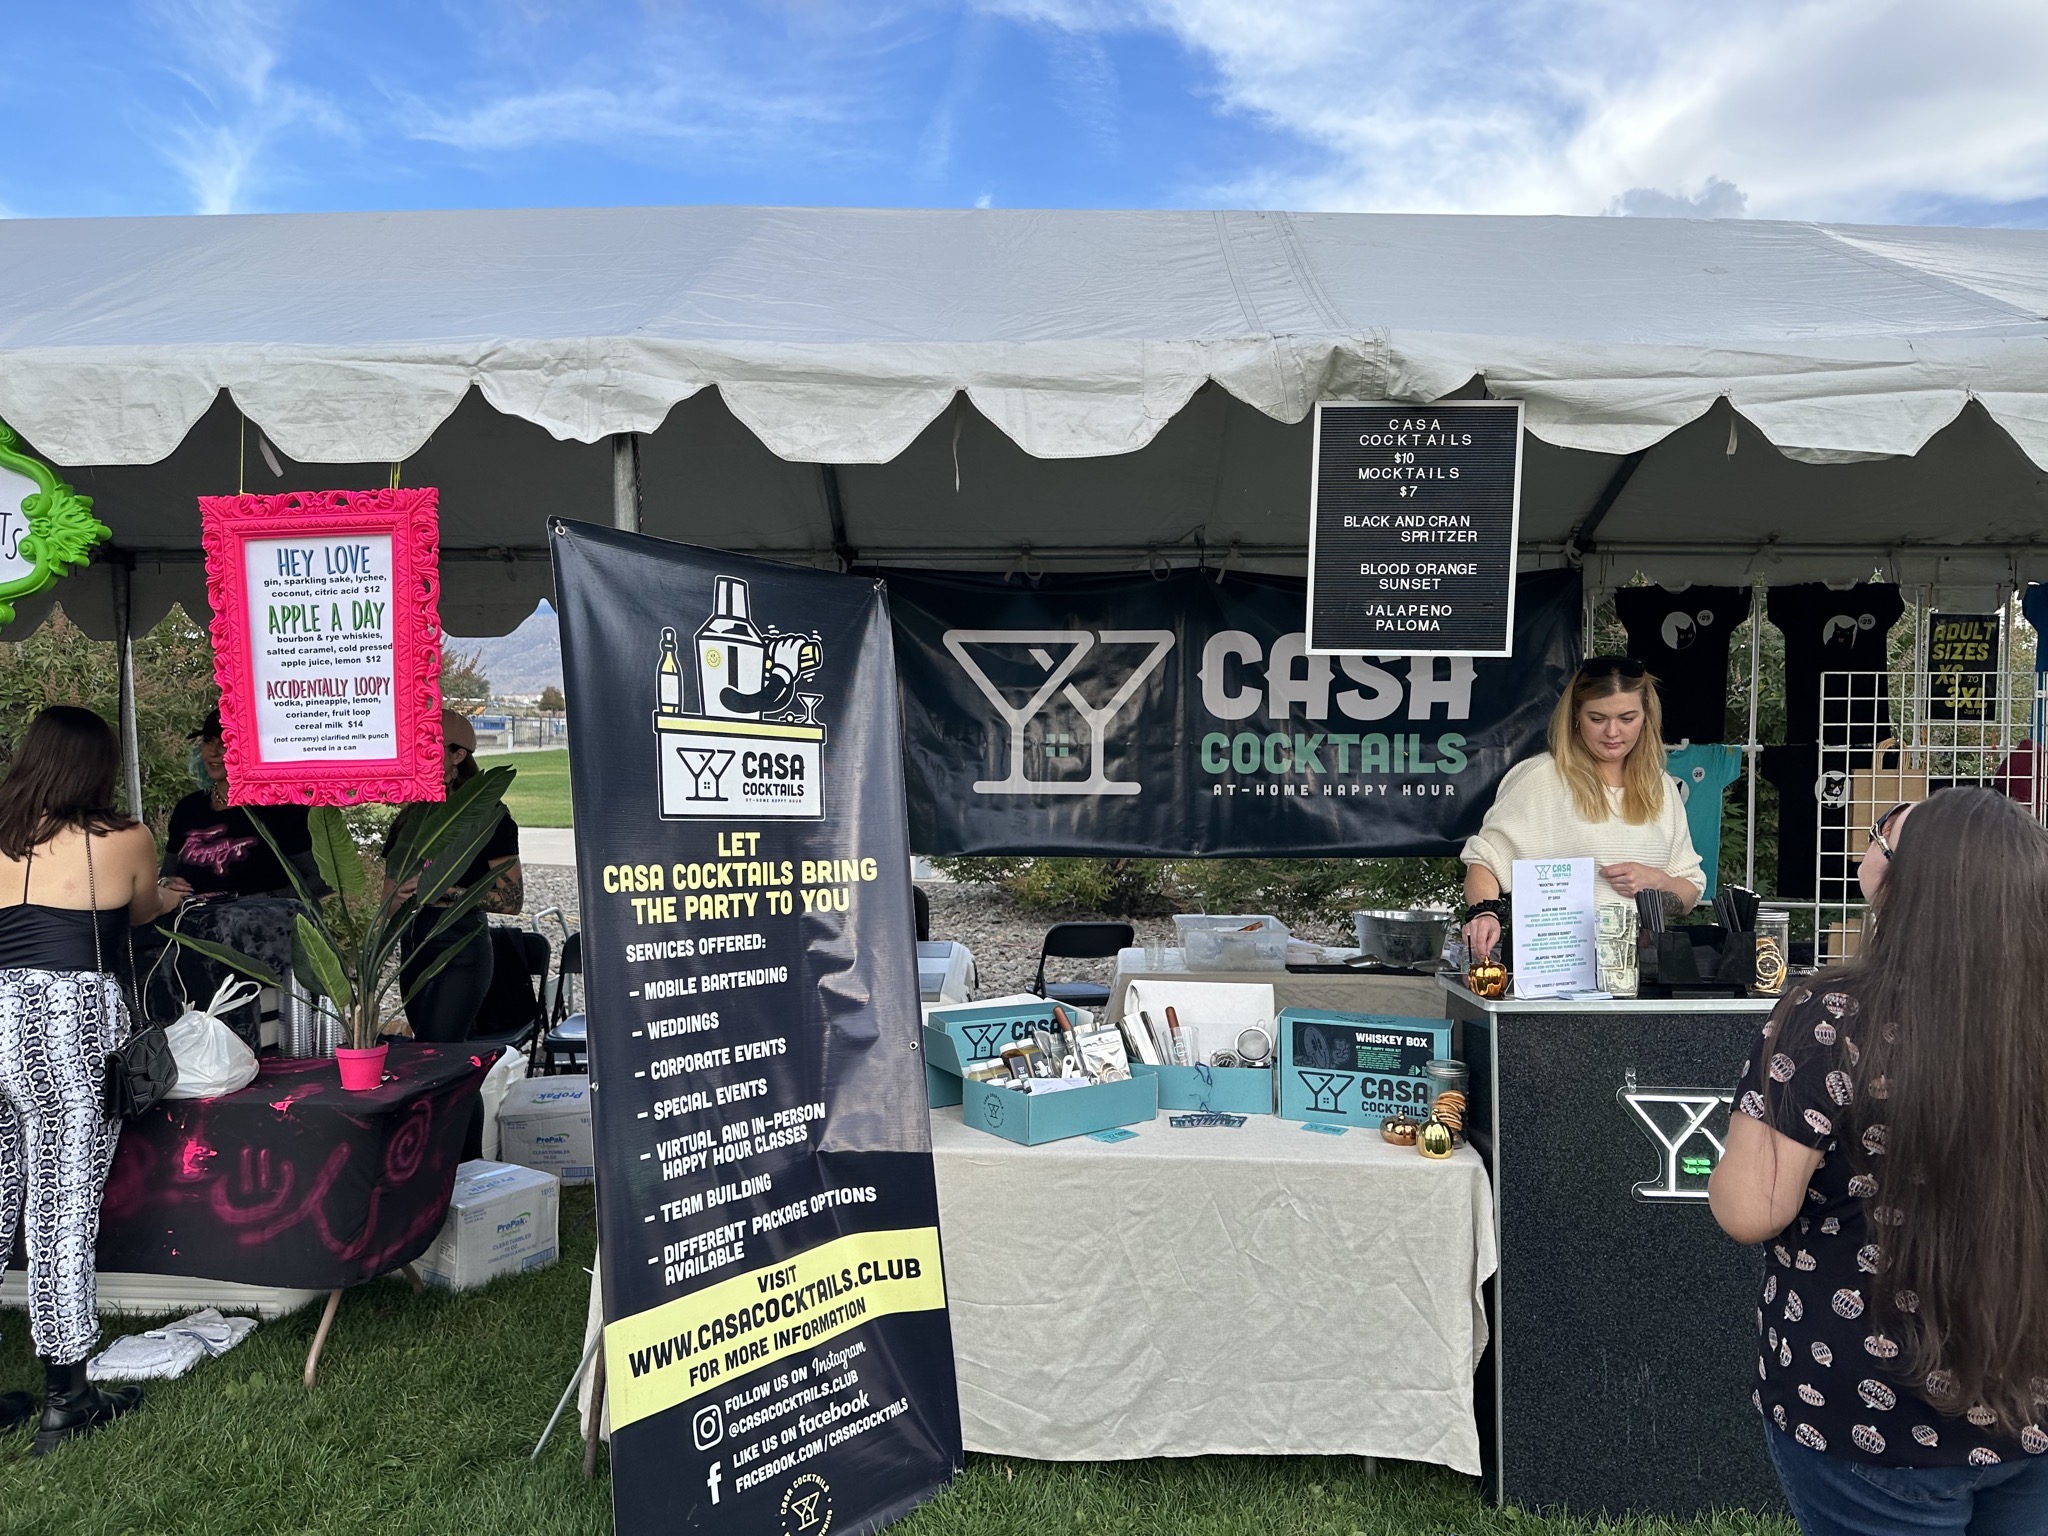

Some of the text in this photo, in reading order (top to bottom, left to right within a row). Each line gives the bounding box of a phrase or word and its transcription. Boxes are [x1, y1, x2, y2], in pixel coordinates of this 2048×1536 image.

[1389, 419, 1440, 430] CASA
[1359, 435, 1472, 445] COCKTAILS
[1395, 453, 1414, 464] $10
[1359, 468, 1459, 479] MOCKTAILS
[1344, 516, 1470, 527] BLACK AND CRAN
[1401, 531, 1477, 542] SPRITZER
[277, 545, 371, 577] HEY LOVE
[1360, 564, 1477, 575] BLOOD ORANGE
[264, 578, 281, 587] gin,
[284, 576, 327, 586] sparkling
[355, 574, 387, 584] lychee,
[272, 589, 313, 598] coconut,
[341, 586, 359, 594] acid
[364, 585, 380, 594] $12
[1379, 579, 1441, 590] SUNSET
[269, 599, 385, 635] APPLE A DAY
[1366, 605, 1452, 616] JALAPENO
[1376, 620, 1440, 631] PALOMA
[1933, 622, 1997, 641] ADULT
[267, 643, 393, 655] salted caramel, cold pressed
[277, 635, 314, 643] bourbon
[317, 634, 323, 642] &
[342, 632, 383, 640] whiskies,
[281, 655, 381, 668] apple juice, lemon $12
[1932, 643, 1990, 661] SIZES
[1197, 630, 1478, 721] CASA
[1935, 664, 1979, 685] XS TO
[267, 677, 390, 700] ACCIDENTALLY LOOPY
[1944, 686, 1988, 709] 3XL
[274, 696, 381, 707] vodka, pineapple, lemon,
[286, 710, 330, 718] coriander,
[352, 708, 371, 717] loop
[295, 720, 363, 730] cereal milk $14
[274, 735, 288, 743] (not
[290, 735, 319, 743] creamy)
[321, 733, 350, 741] clarified
[368, 732, 389, 740] punch
[1201, 733, 1468, 774] COCKTAILS
[742, 751, 805, 780] CASA
[743, 782, 804, 796] COCKTAILS
[1213, 784, 1456, 797] AT-HOME HAPPY HOUR
[718, 832, 760, 857] LET
[602, 858, 878, 893] CASA COCKTAILS BRING
[1552, 864, 1571, 872] CASA
[631, 888, 850, 925] THE PARTY TO YOU
[626, 933, 766, 963] SERVICES OFFERED:
[644, 966, 788, 1000] MOBILE BARTENDING
[648, 1012, 719, 1040] WEDDINGS
[1355, 1033, 1428, 1047] WHISKEY BOX
[650, 1037, 786, 1080] CORPORATE EVENTS
[653, 1078, 768, 1121] SPECIAL EVENTS
[1361, 1077, 1427, 1104] CASA
[1362, 1101, 1428, 1117] COCKTAILS
[656, 1102, 826, 1162] VIRTUAL AND IN-PERSON
[662, 1124, 808, 1182] HAPPY HOUR CLASSES
[660, 1173, 772, 1223] TEAM BUILDING
[497, 1218, 525, 1233] ProPak
[663, 1186, 877, 1265] DIFFERENT PACKAGE OPTIONS
[664, 1241, 745, 1286] AVAILABLE
[757, 1265, 797, 1293] VISIT
[629, 1258, 921, 1378] WWW.CASACOCKTAILS.CLUB
[689, 1297, 867, 1387] FOR MORE INFORMATION
[725, 1340, 866, 1414] FOLLOW US ON Instagram
[728, 1369, 859, 1438] @CASACOCKTAILS.CLUB
[733, 1389, 870, 1469] LIKE US ON facebook
[735, 1397, 909, 1493] FACEBOOK.COM/CASACOCKTAILS
[780, 1474, 829, 1514] CASA COCKTAILS
